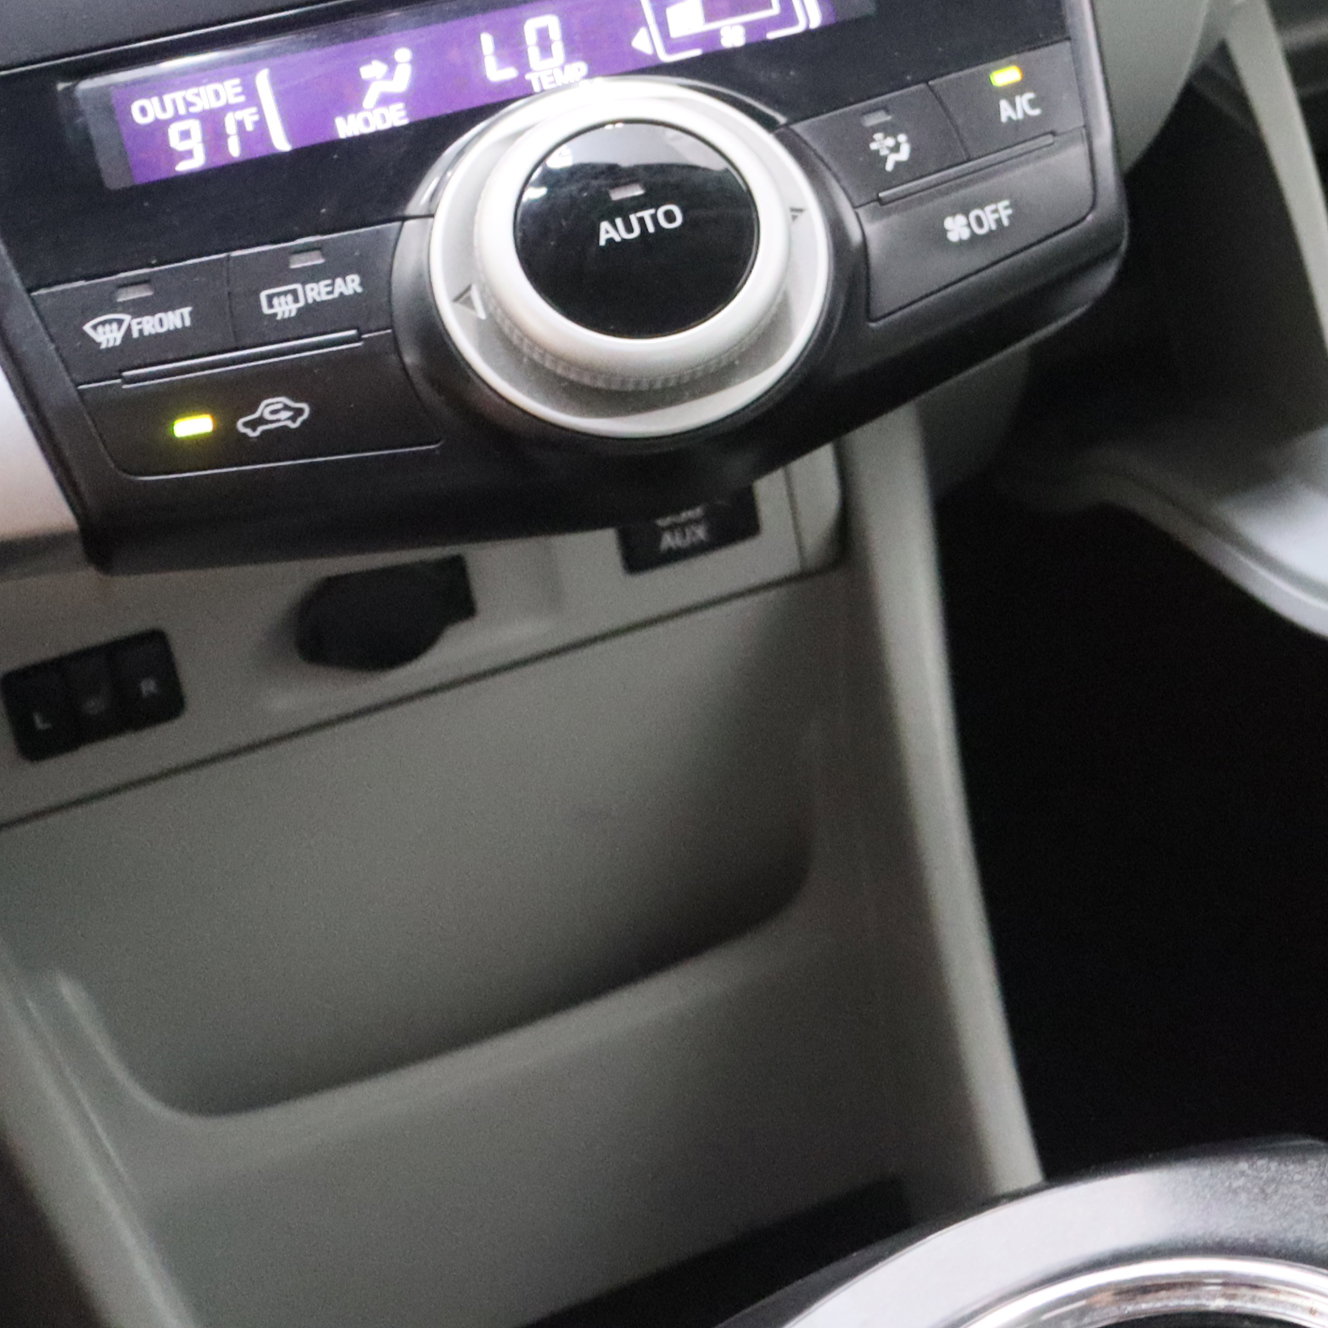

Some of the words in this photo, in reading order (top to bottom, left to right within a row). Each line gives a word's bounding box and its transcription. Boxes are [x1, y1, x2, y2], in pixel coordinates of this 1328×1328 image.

[525, 60, 589, 93] TEMP
[130, 78, 246, 125] OUTSIDE
[998, 92, 1042, 123] A/C
[335, 102, 410, 140] MODE
[598, 203, 684, 247] AUTO
[968, 200, 1014, 236] OFF
[304, 274, 363, 305] REAR
[130, 306, 193, 339] FRONT
[659, 522, 708, 552] AUX
